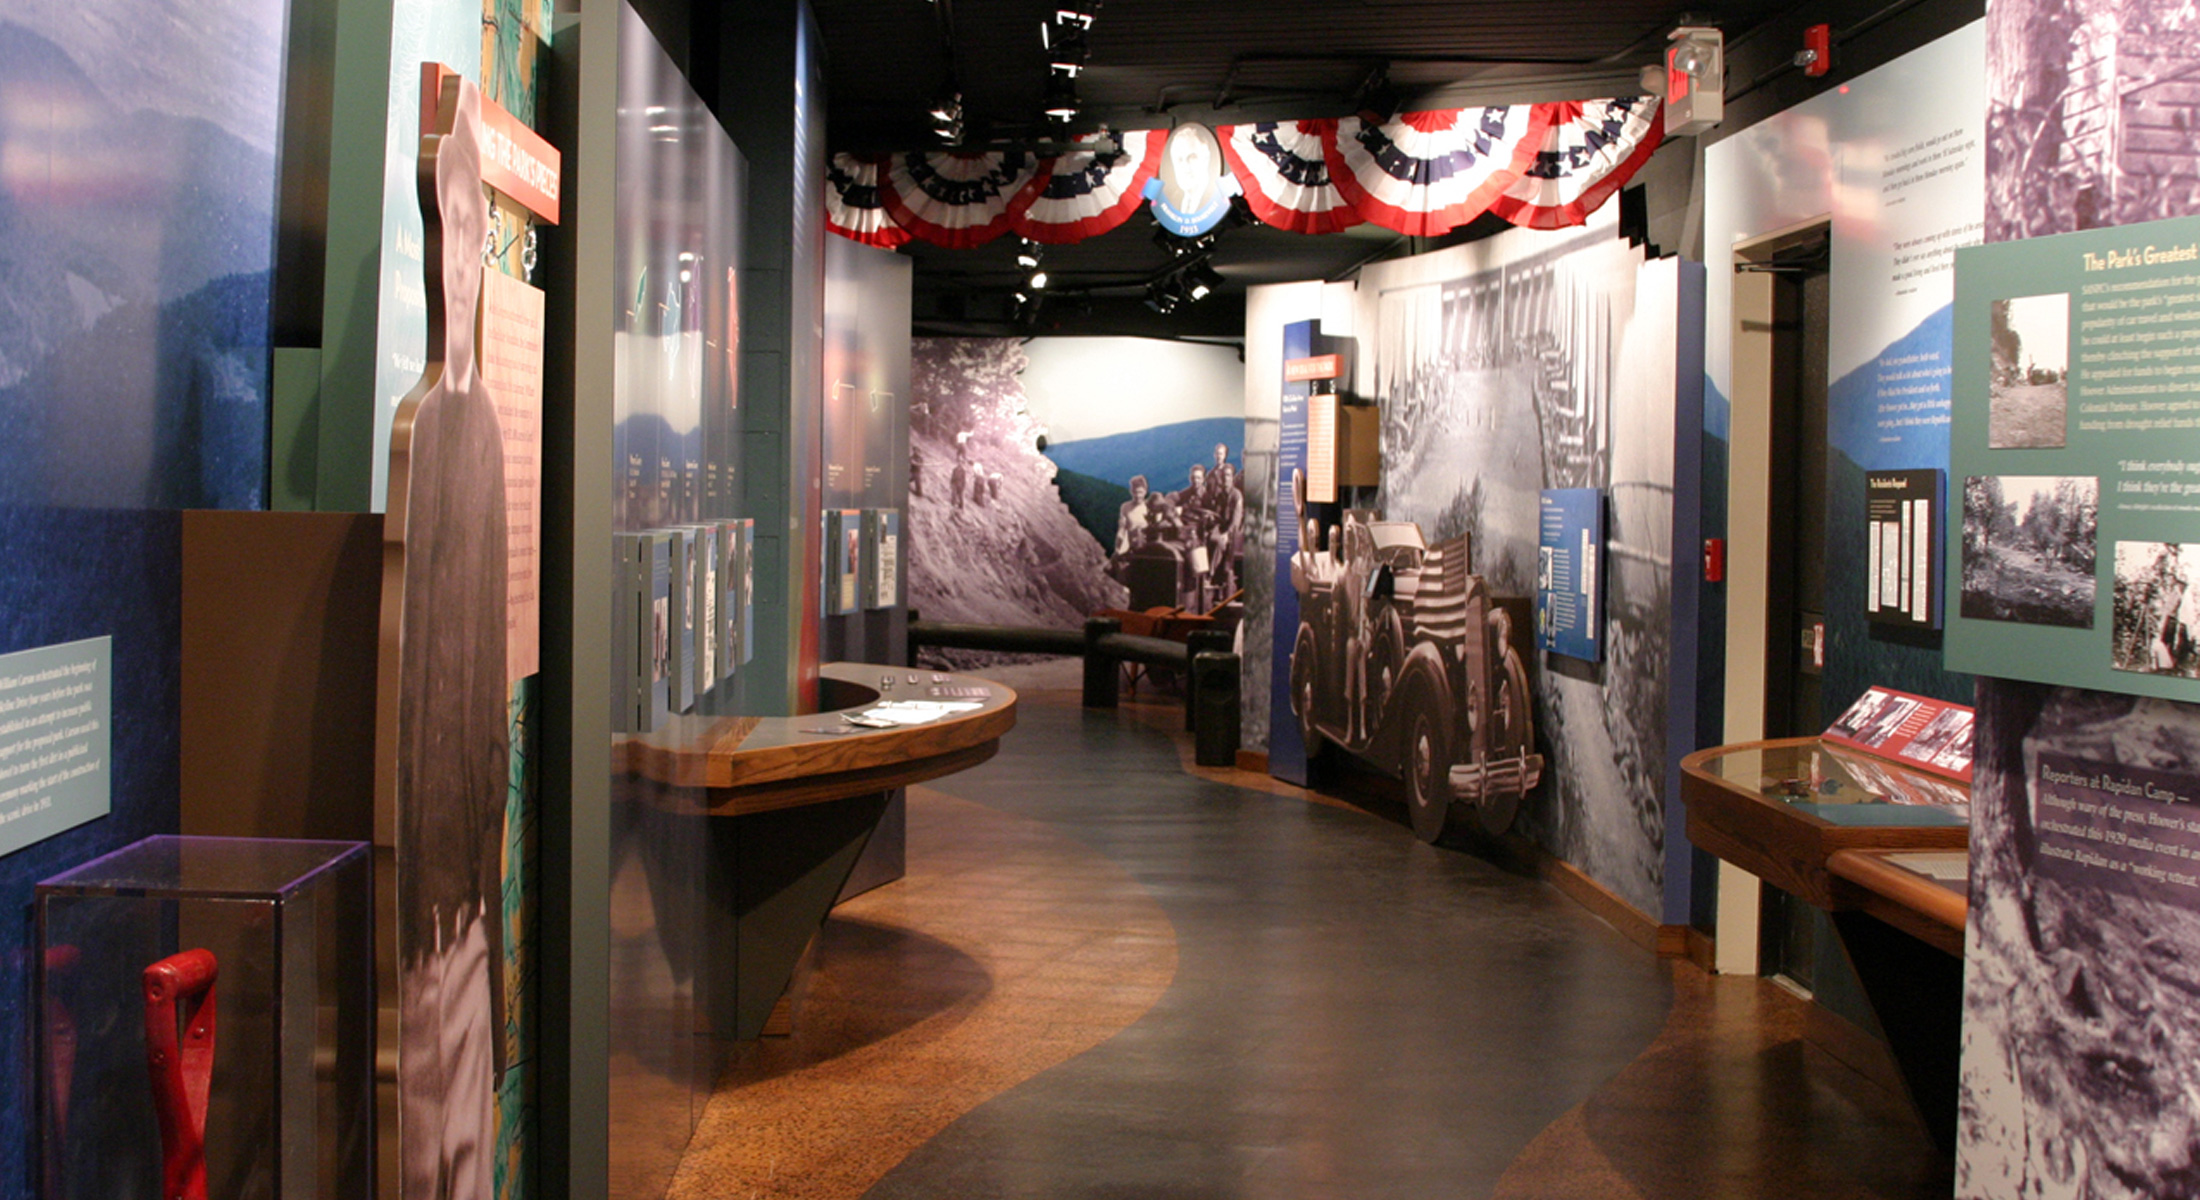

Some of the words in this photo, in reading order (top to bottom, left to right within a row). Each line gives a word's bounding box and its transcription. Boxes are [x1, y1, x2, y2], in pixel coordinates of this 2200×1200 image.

[2083, 252, 2105, 271] The
[2107, 247, 2142, 269] Park's
[2144, 243, 2199, 265] Greatest
[2127, 460, 2146, 472] think
[2122, 481, 2142, 492] think
[2042, 764, 2088, 787] Reporters
[2090, 775, 2100, 789] at
[2102, 774, 2143, 796] Rapidan
[2041, 793, 2077, 812] Although
[2098, 803, 2109, 818] of
[2109, 804, 2122, 819] the
[2087, 827, 2103, 841] this
[2105, 830, 2128, 846] 1929
[2155, 843, 2178, 857] event
[2074, 849, 2108, 868] Rapidan
